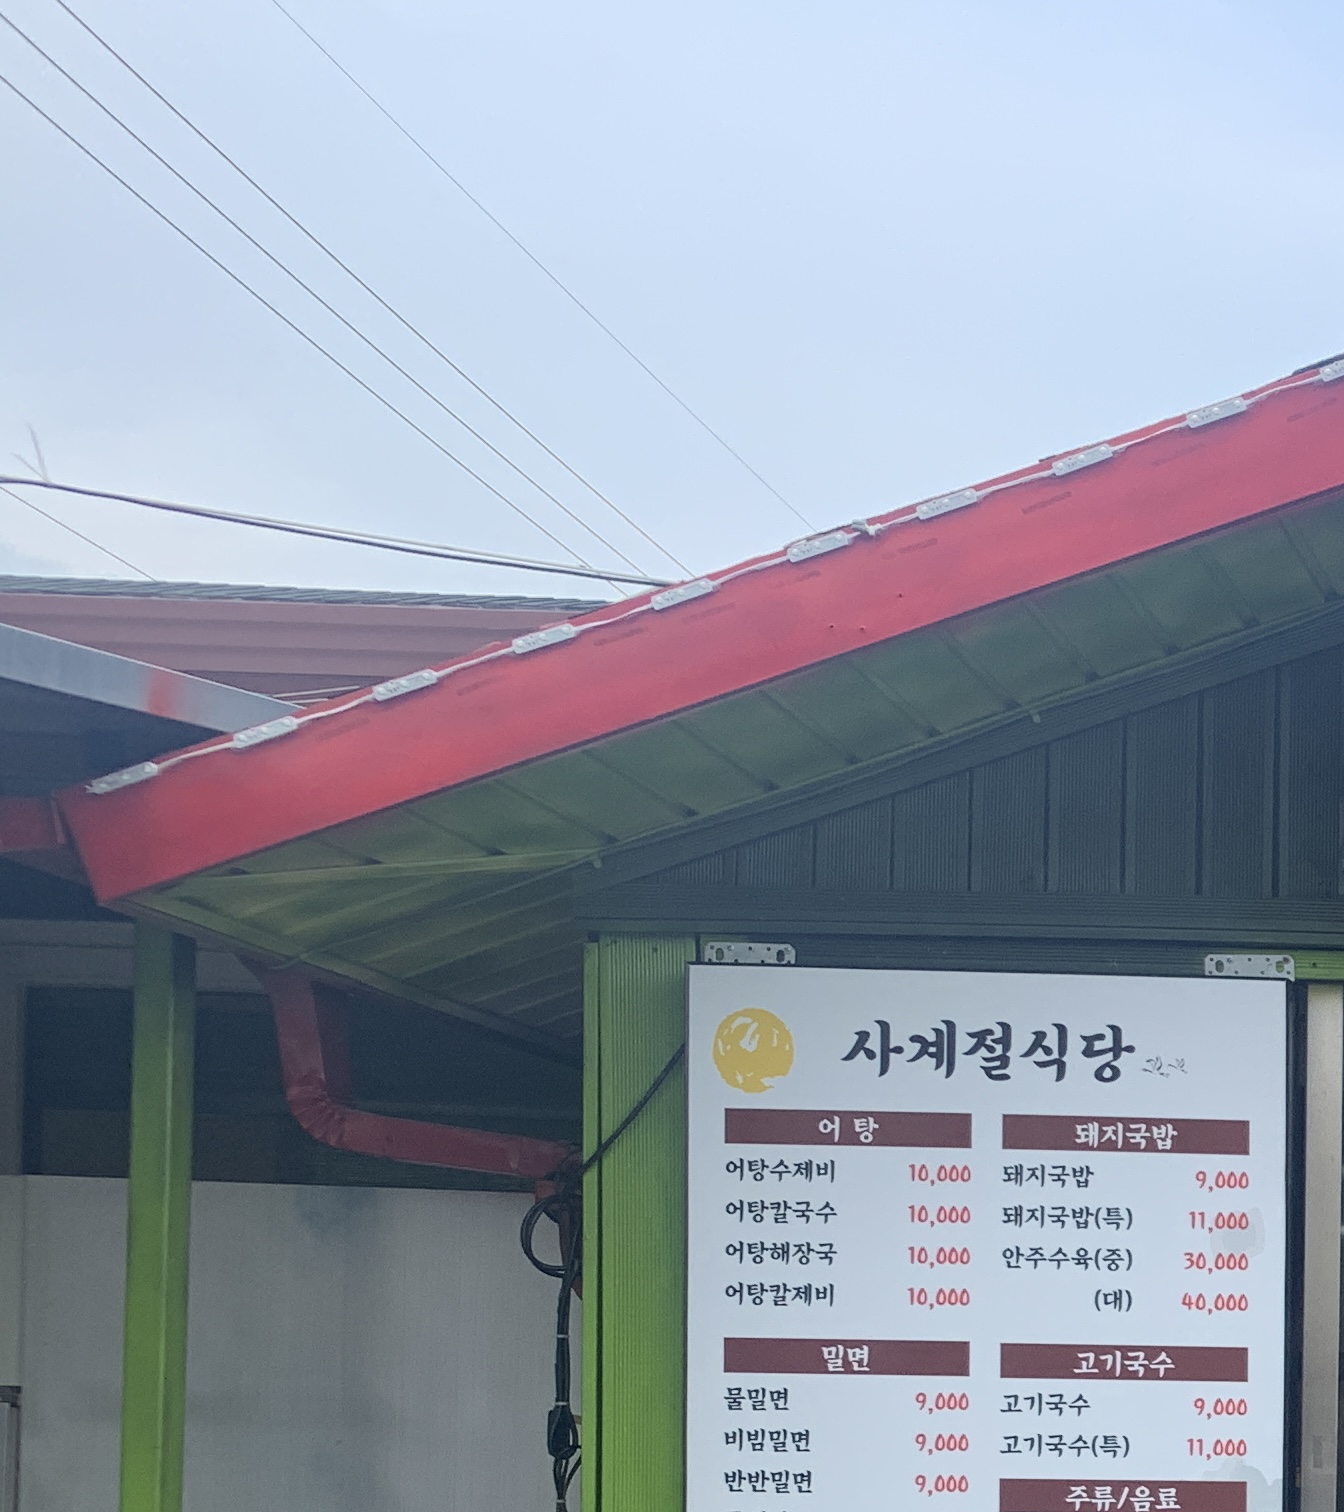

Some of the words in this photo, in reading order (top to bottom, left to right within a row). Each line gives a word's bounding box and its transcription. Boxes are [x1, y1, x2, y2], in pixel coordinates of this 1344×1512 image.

[840, 1019, 1136, 1083] 사계절식당
[1075, 1121, 1178, 1150] 돼지국밥
[725, 1157, 835, 1183] 어탕수제비
[908, 1163, 971, 1187] 10,000
[1002, 1163, 1095, 1189] 돼지국밥
[1195, 1170, 1250, 1193] 9,000
[725, 1199, 838, 1224] 어탕칼국수
[907, 1204, 971, 1228] 10,000
[1001, 1204, 1133, 1231] 돼지국밥(특)
[1188, 1211, 1250, 1234] 11,000
[725, 1240, 838, 1266] 어탕해장국
[907, 1246, 971, 1270] 10,000
[1001, 1245, 1133, 1272] 안주수육(중)
[1183, 1251, 1249, 1275] 30,000
[724, 1281, 835, 1307] 어탕칼제비
[907, 1287, 971, 1311] 10,000
[1094, 1288, 1133, 1313] (대)
[1181, 1292, 1249, 1316] 40,000
[821, 1343, 871, 1375] 밀면
[1073, 1350, 1176, 1378] 고기국수
[723, 1387, 789, 1411] 물밀면
[915, 1392, 969, 1415] 9,000
[999, 1392, 1091, 1417] 고기국수
[1193, 1397, 1248, 1420] 9,000
[724, 1427, 811, 1453] 비빔밀면
[914, 1433, 969, 1456] 9,000
[999, 1433, 1130, 1459] 고기국수(특)
[1186, 1438, 1247, 1461] 11,000
[723, 1469, 813, 1494] 반반밀면
[914, 1474, 969, 1498] 9,000
[1065, 1486, 1182, 1512] 주류/음료
